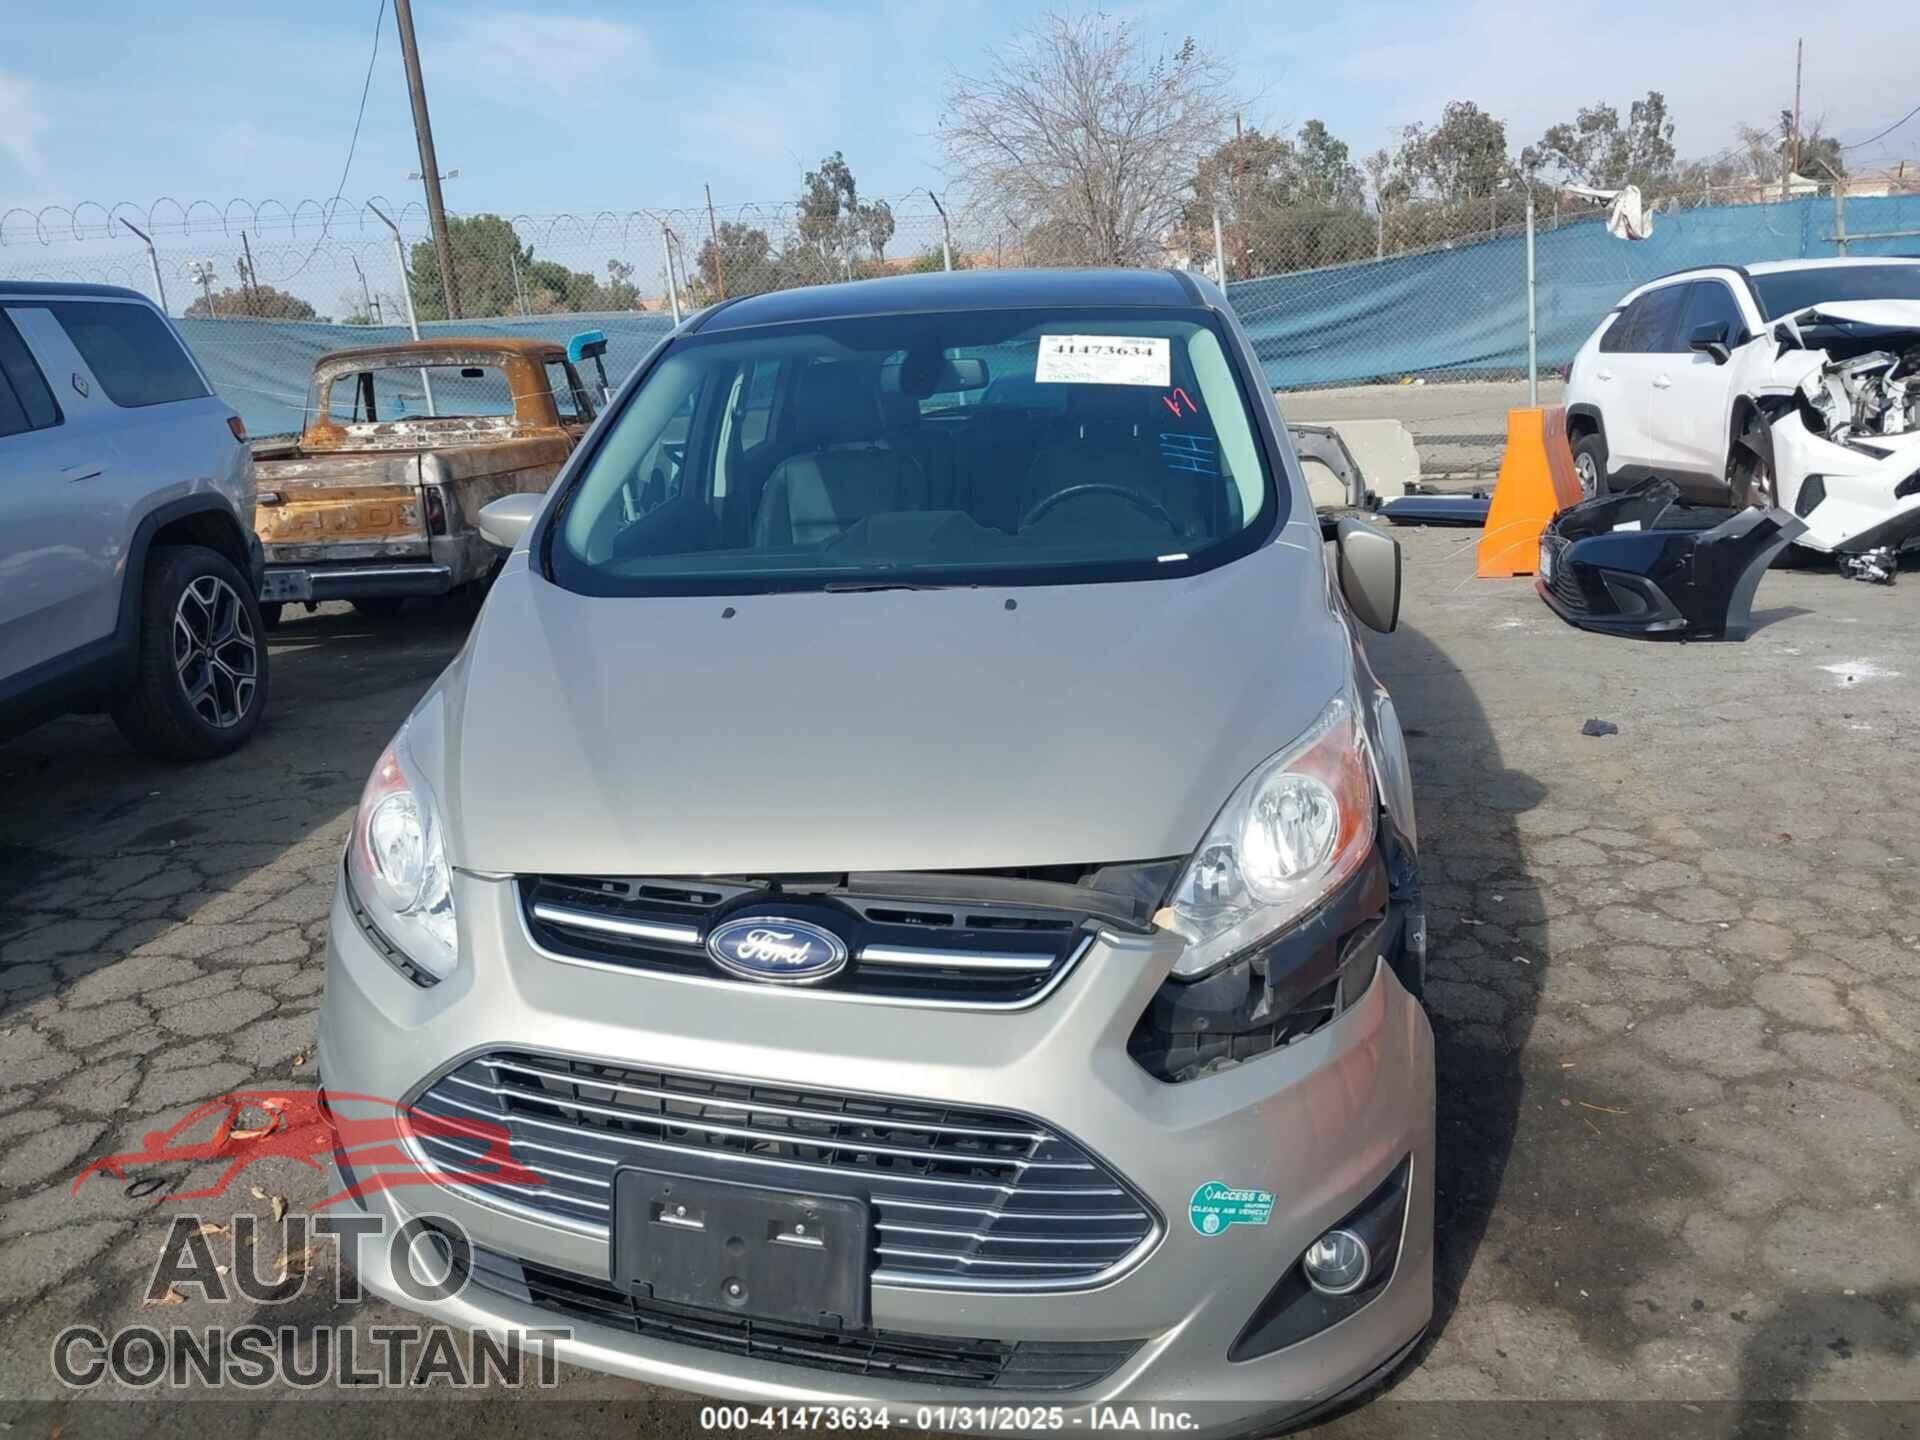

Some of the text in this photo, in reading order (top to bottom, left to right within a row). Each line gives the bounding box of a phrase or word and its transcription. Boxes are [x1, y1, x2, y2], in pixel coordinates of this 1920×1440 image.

[1054, 344, 1153, 357] 41473634
[737, 929, 811, 964] Ford
[1213, 1191, 1255, 1201] ACCESS
[1192, 1205, 1220, 1213] CLEAN
